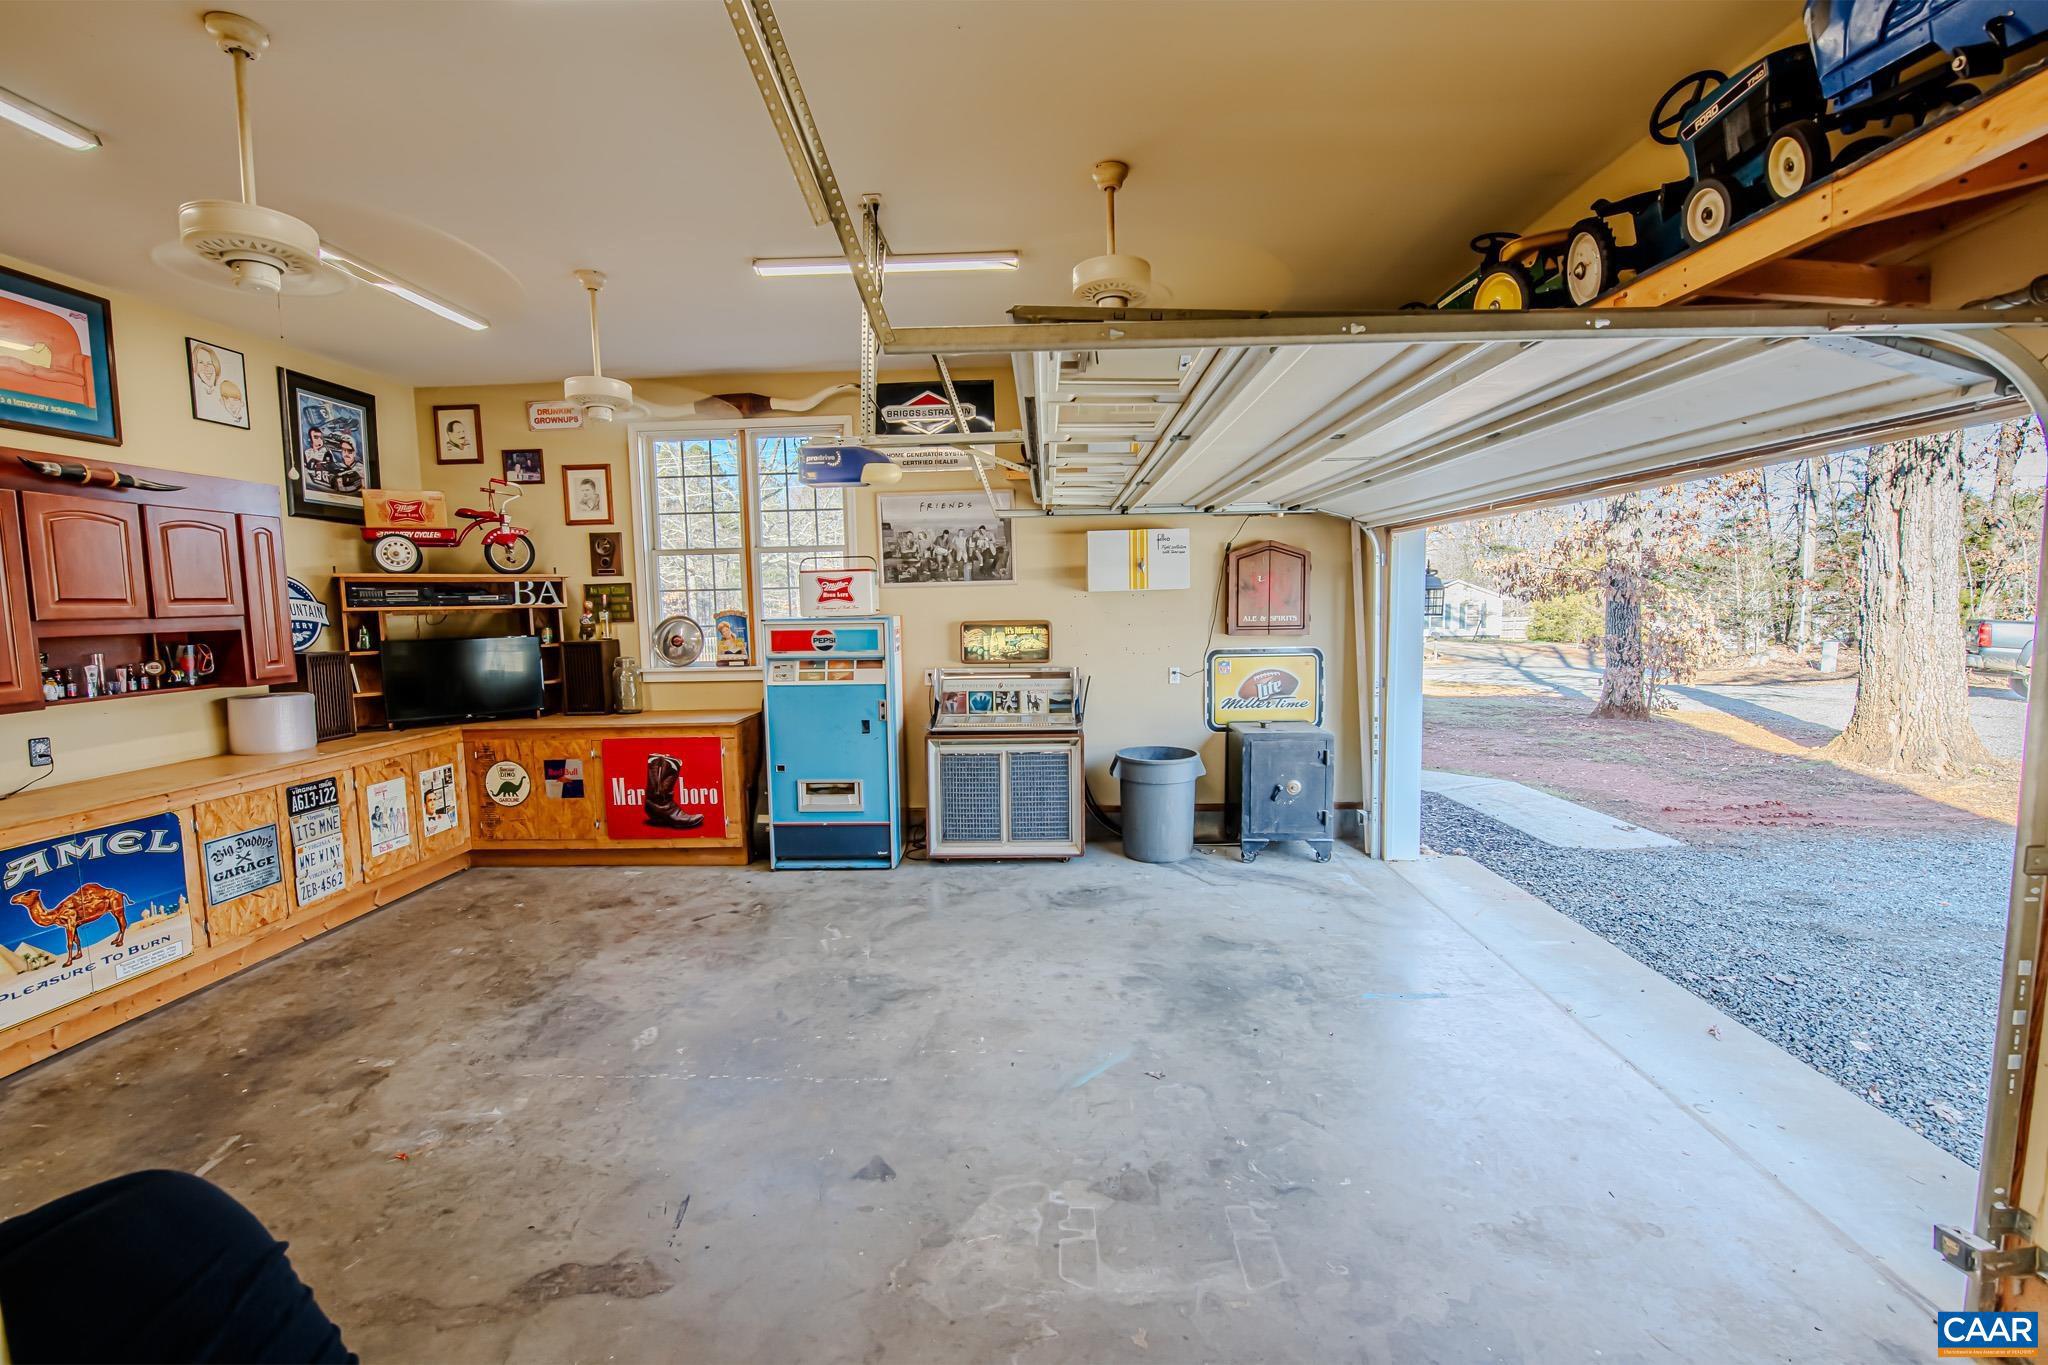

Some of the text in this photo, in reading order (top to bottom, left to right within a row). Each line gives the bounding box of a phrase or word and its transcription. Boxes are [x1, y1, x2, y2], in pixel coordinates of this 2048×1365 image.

[1695, 104, 1718, 130] FORD
[14, 398, 48, 411] temporary
[51, 405, 77, 416] solution.
[534, 416, 578, 424] GROWNUPS
[806, 455, 835, 463] prodrive
[920, 502, 973, 512] FRIENDS
[822, 581, 849, 591] Miller
[290, 603, 324, 619] UNTAIN
[1005, 626, 1014, 634] It's
[1015, 626, 1032, 634] Miller
[1221, 696, 1309, 709] Miller Time
[563, 767, 578, 776] Bull
[292, 785, 318, 795] VIRGINIA
[296, 814, 339, 842] ITS MNE
[211, 834, 274, 867] Big Daddy's
[3, 829, 180, 890] AMEL
[213, 855, 276, 882] GARAGE
[101, 951, 123, 965] TO
[128, 934, 171, 956] BURN
